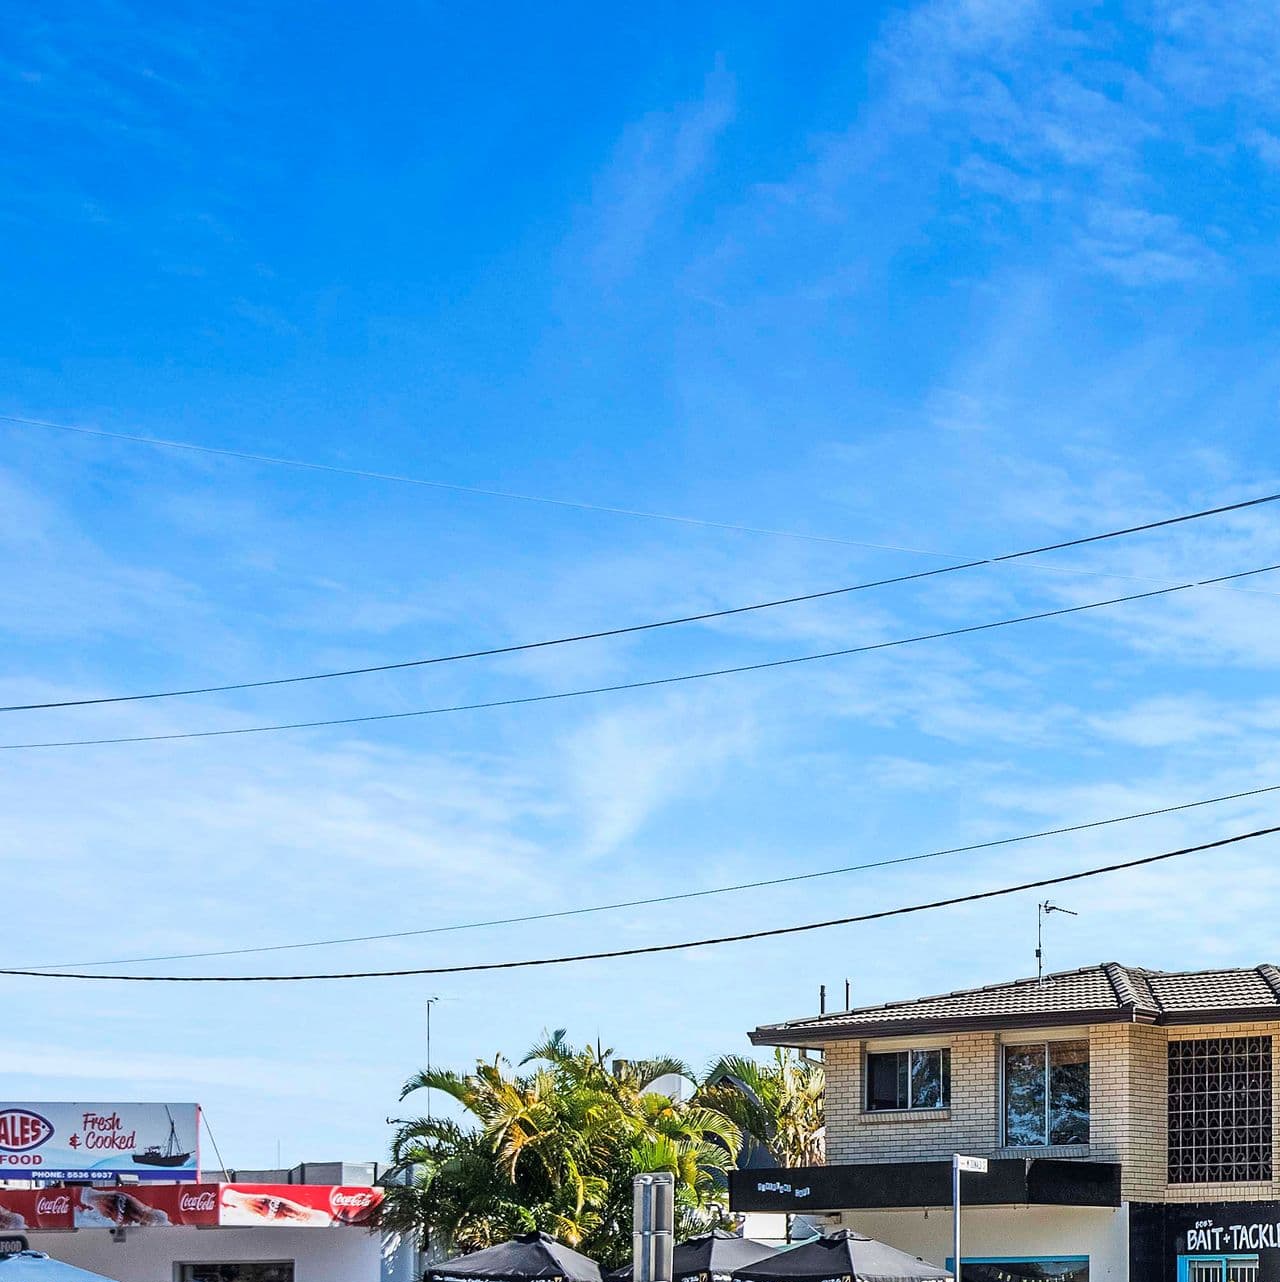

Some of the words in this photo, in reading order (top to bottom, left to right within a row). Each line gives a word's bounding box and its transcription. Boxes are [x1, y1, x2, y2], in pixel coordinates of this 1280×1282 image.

[83, 1112, 122, 1131] Fresh
[69, 1133, 82, 1149] &
[85, 1131, 137, 1150] Cooked
[1187, 1227, 1224, 1250] BAIT
